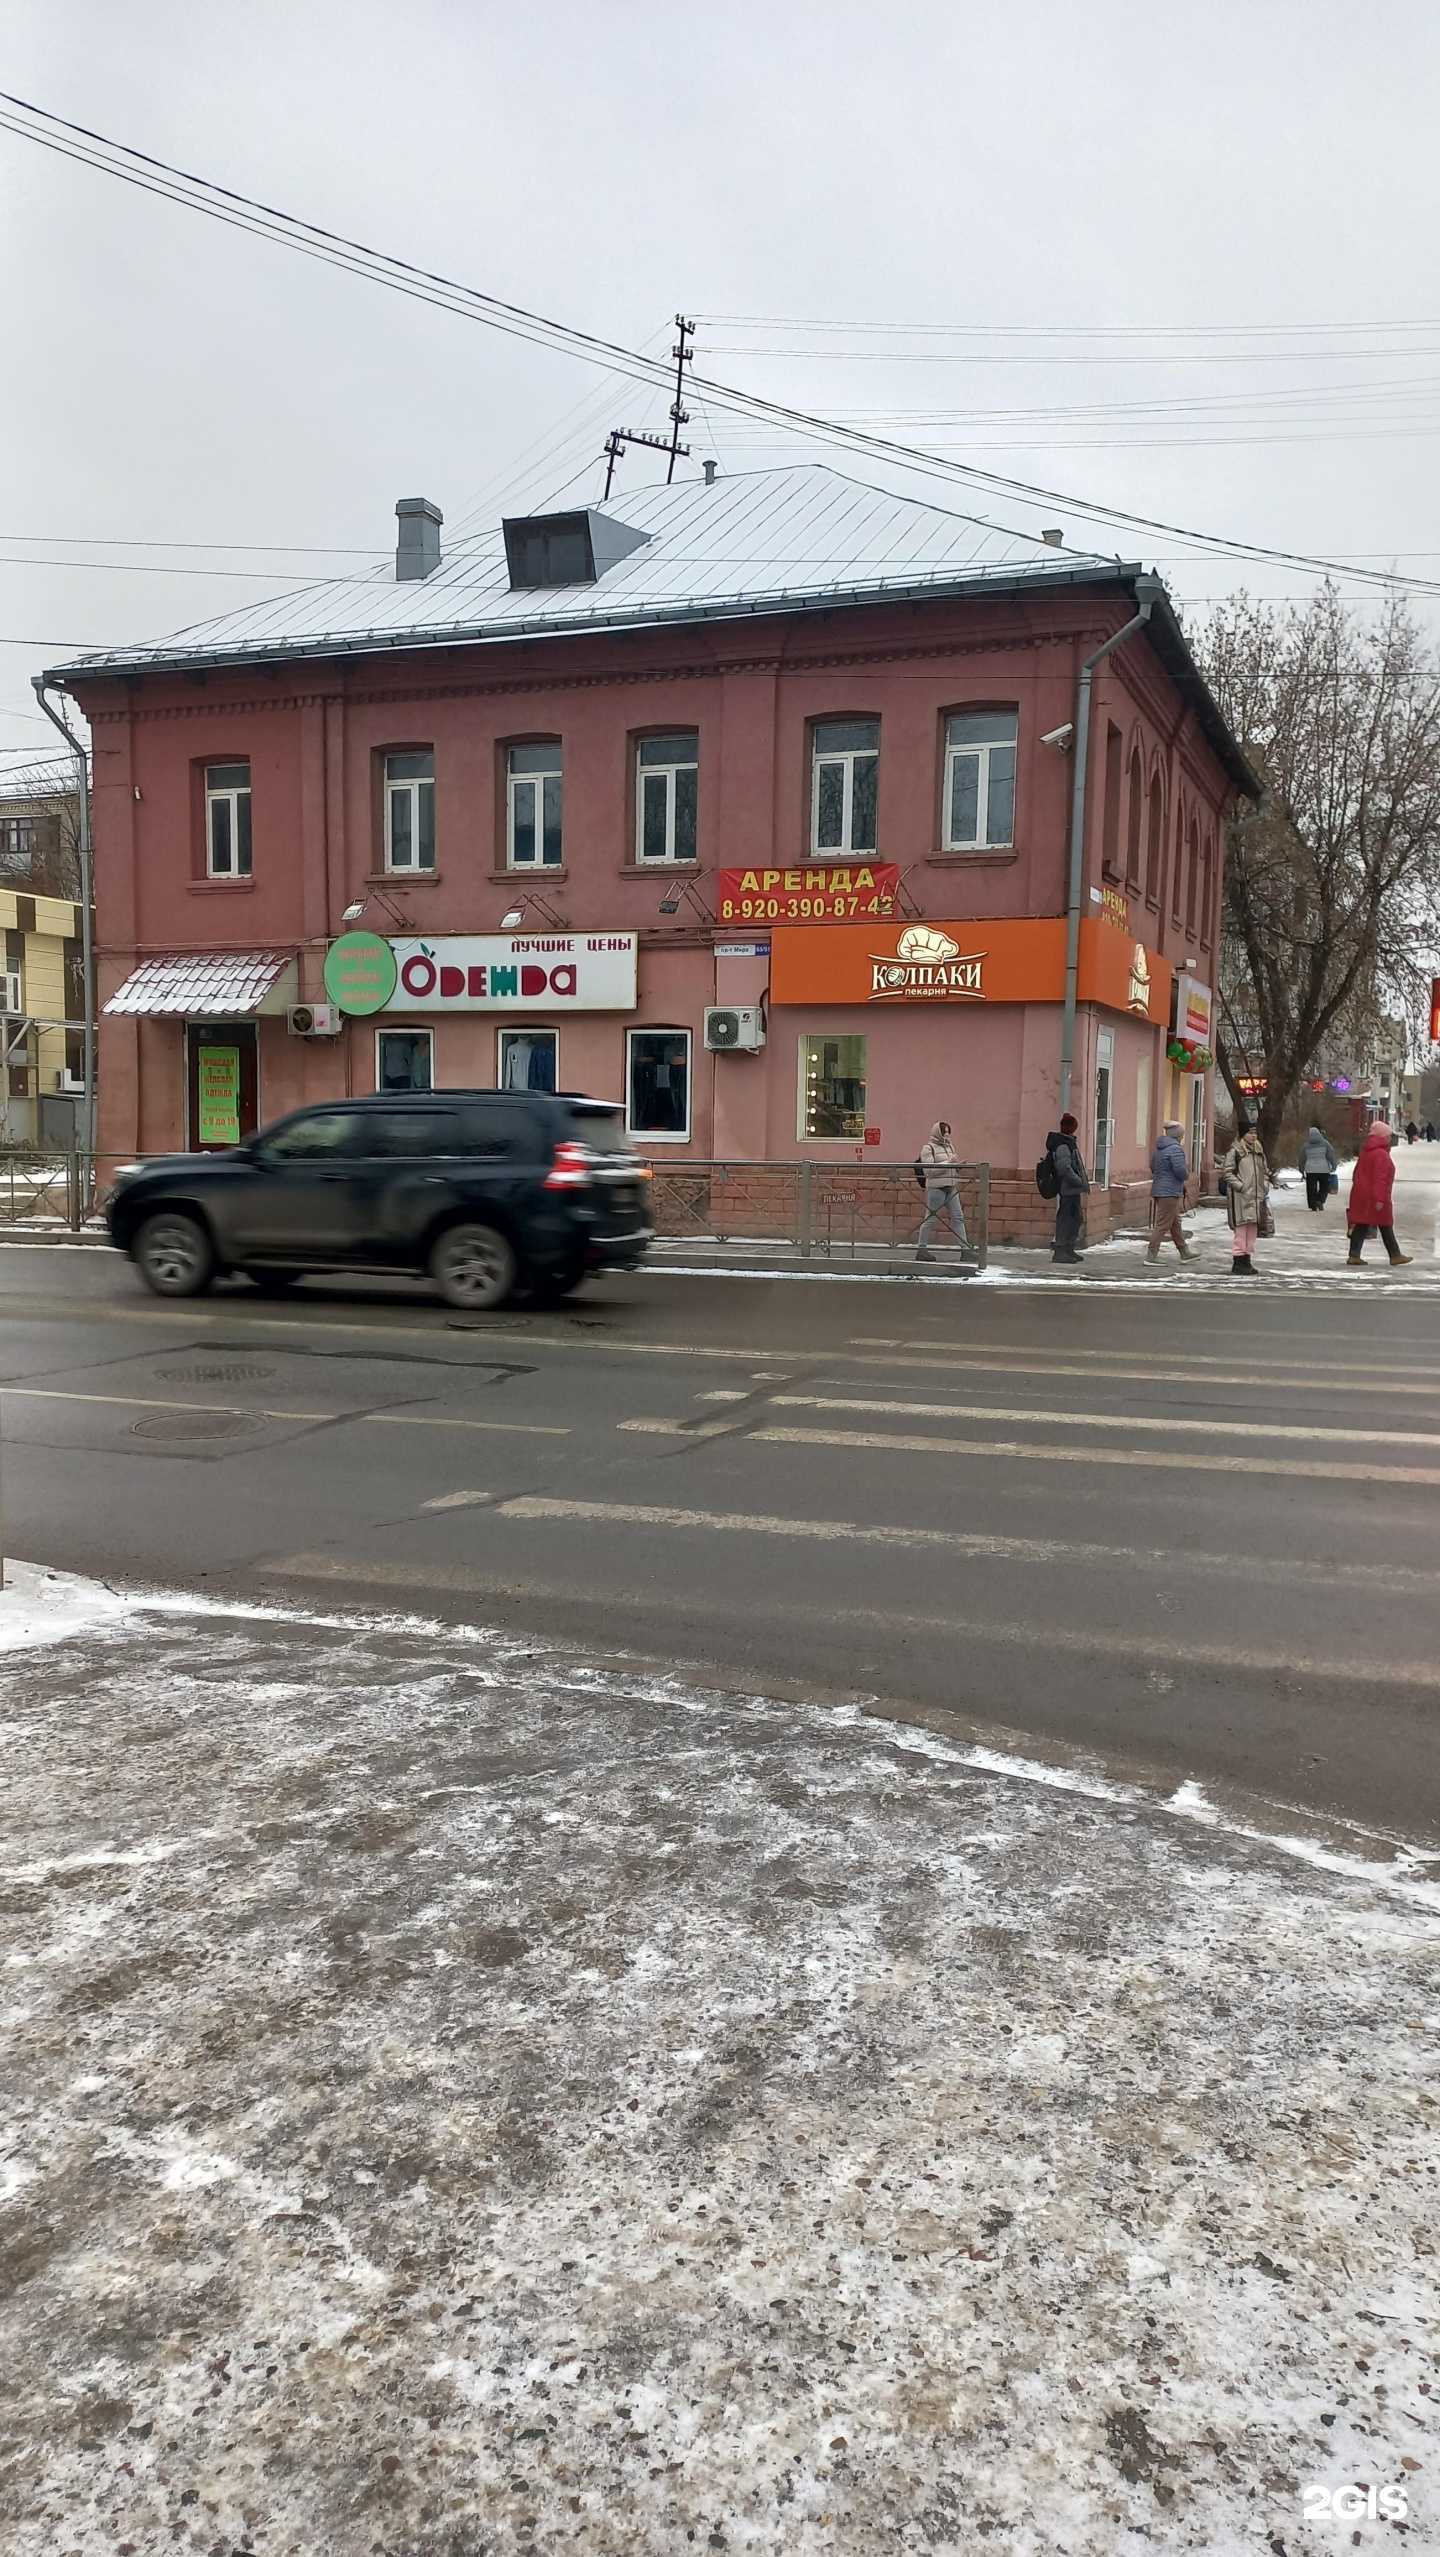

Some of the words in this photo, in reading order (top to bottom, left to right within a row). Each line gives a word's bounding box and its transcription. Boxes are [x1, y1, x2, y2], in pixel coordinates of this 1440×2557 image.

[740, 868, 875, 893] АРЕНДА
[722, 895, 893, 919] 8-920-390-87-42
[511, 939, 576, 953] ЛУЧШИЕ
[586, 938, 632, 951] ЦЕНЫ
[871, 962, 982, 991] КОЛПАКИ
[904, 987, 947, 996] пекарня
